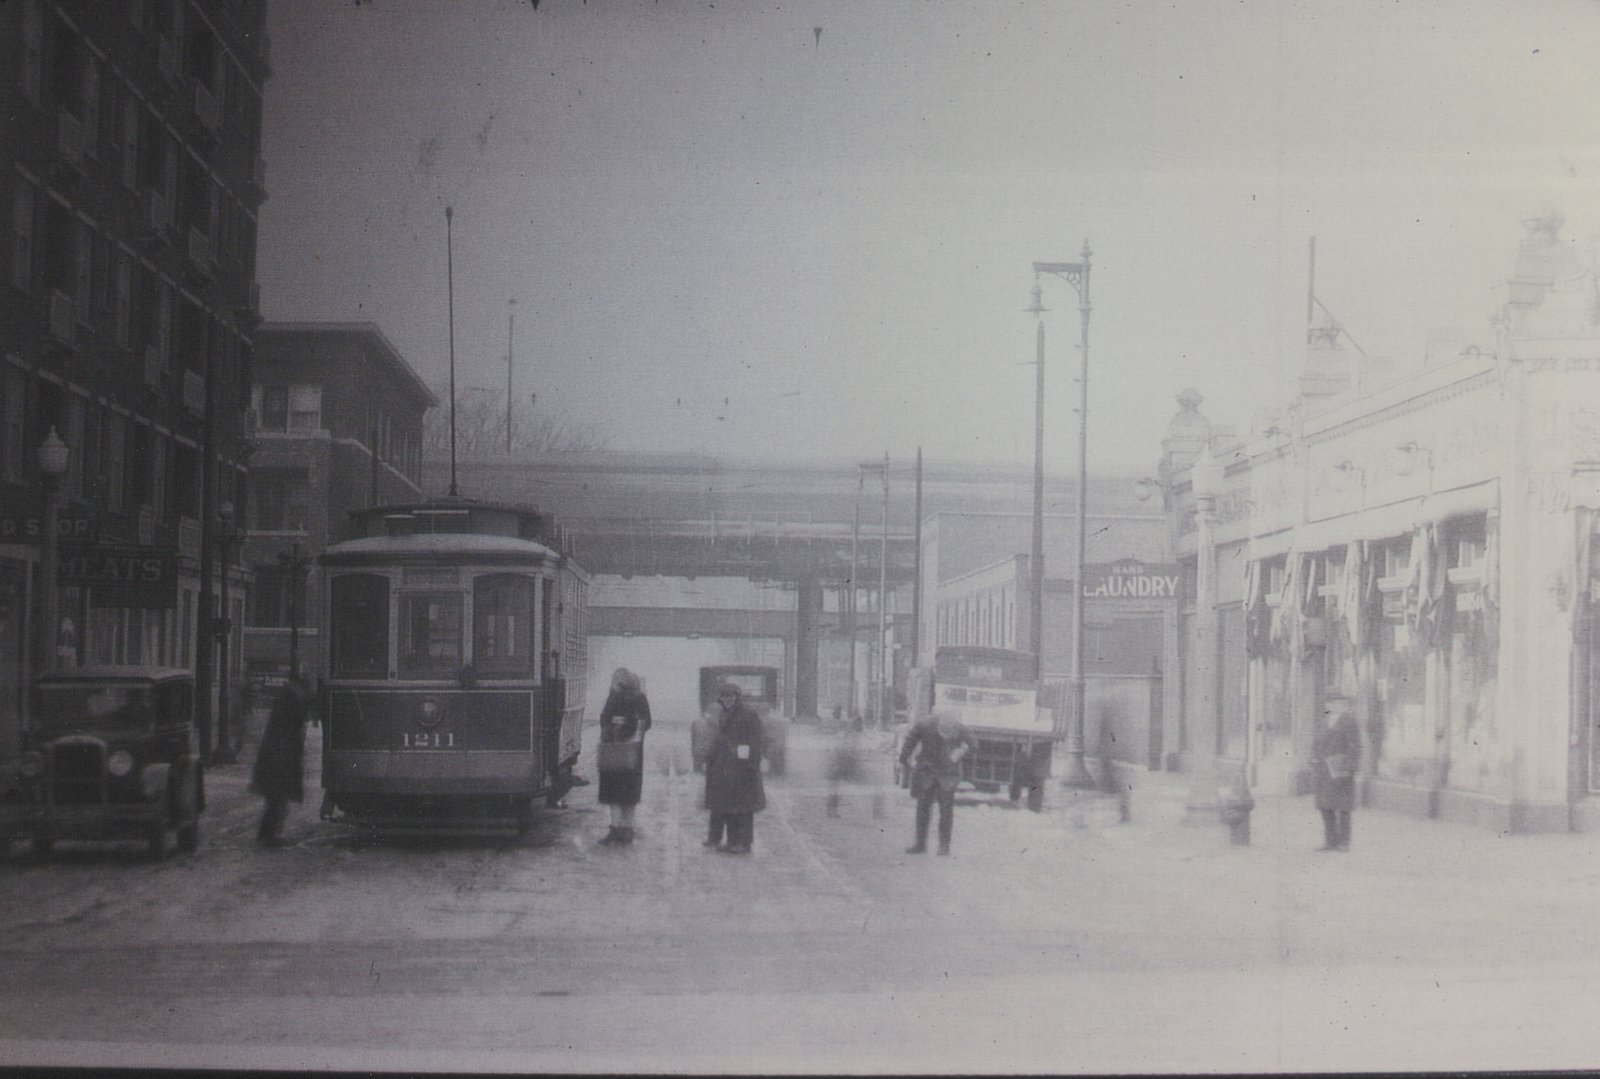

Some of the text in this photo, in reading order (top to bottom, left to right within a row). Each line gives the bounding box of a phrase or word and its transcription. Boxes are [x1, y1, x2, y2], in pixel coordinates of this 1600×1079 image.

[26, 518, 89, 536] SOP
[1083, 575, 1179, 597] LAUNDRY
[402, 733, 454, 747] 1211
